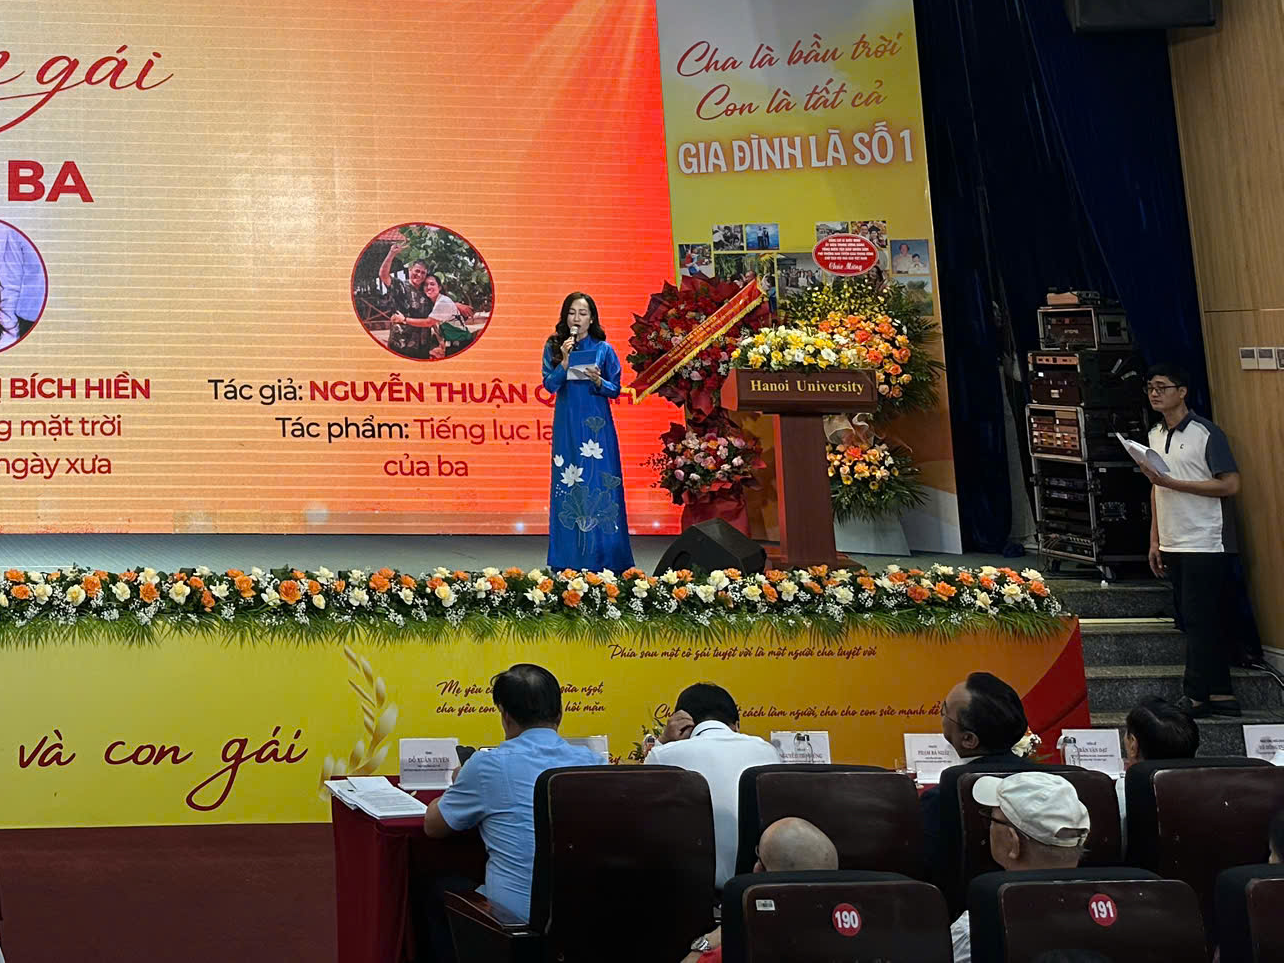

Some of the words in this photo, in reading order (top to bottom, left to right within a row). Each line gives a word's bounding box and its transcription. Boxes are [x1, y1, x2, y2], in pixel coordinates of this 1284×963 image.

[676, 41, 743, 77] Cha
[750, 43, 780, 70] là
[696, 84, 760, 121] Con
[766, 87, 797, 114] là
[851, 79, 887, 107] cả
[677, 140, 728, 174] GIA
[732, 133, 803, 171] ĐÌNH
[809, 128, 848, 168] LÀ
[899, 129, 913, 162] 1
[8, 160, 95, 203] BA
[10, 372, 76, 399] BÍCH
[85, 371, 150, 399] HIỀN
[207, 378, 253, 401] Tác
[259, 378, 304, 406] giả:
[309, 373, 424, 403] NGUYỄN
[430, 377, 528, 409] THUẬN
[750, 379, 789, 392] Hanoi
[797, 379, 864, 395] University
[20, 415, 74, 442] mặt
[79, 413, 123, 437] trời
[275, 417, 321, 438] Tác
[327, 414, 410, 444] phẩm:
[413, 416, 486, 445] Tiếng
[493, 419, 531, 446] lục
[65, 454, 112, 475] xưa
[383, 453, 430, 477] của
[437, 454, 469, 477] ba
[817, 646, 835, 657] cha
[436, 679, 462, 697] Mẹ
[464, 684, 483, 697] yêu
[436, 702, 455, 714] cha
[478, 704, 496, 714] con
[820, 706, 838, 717] cha
[840, 705, 857, 717] cho
[859, 708, 877, 717] con
[18, 729, 76, 768] và
[104, 739, 195, 766] con
[185, 725, 309, 812] gái
[834, 910, 860, 929] 190
[1090, 900, 1115, 919] 191
